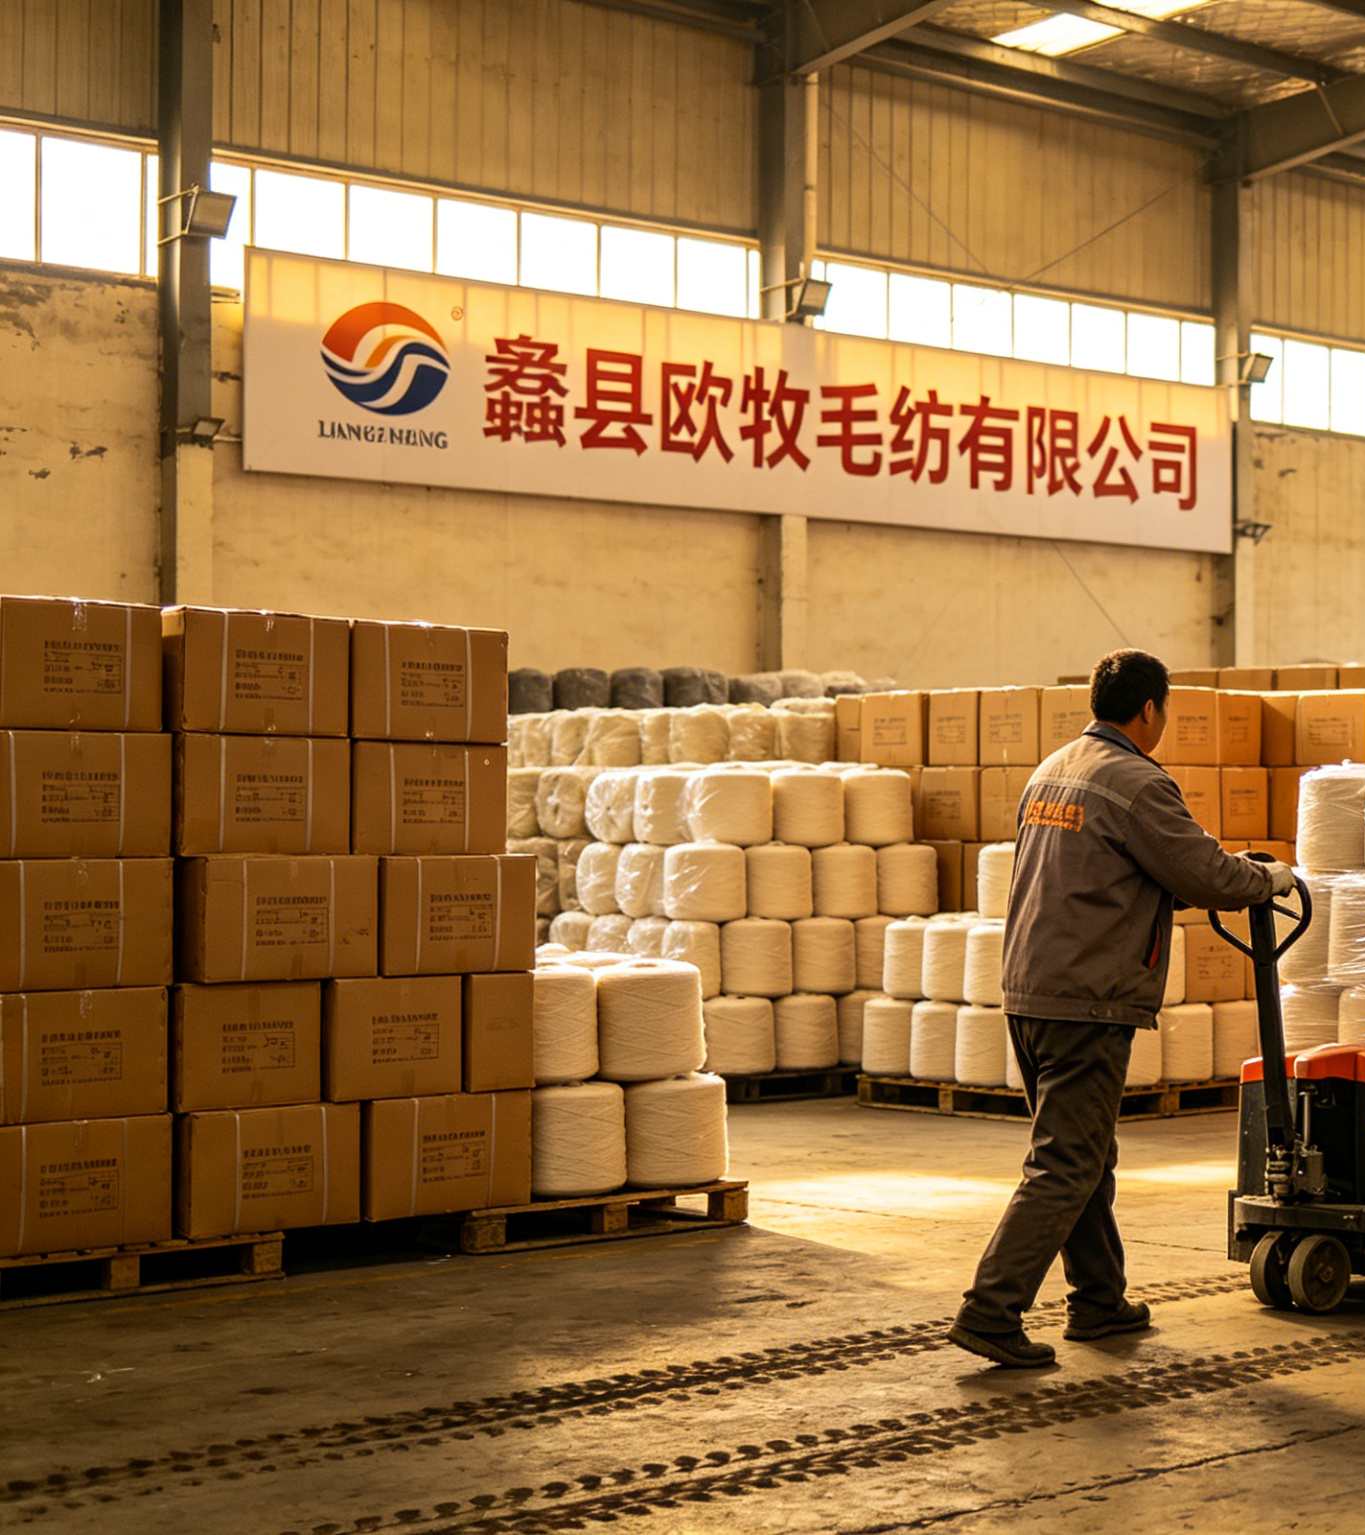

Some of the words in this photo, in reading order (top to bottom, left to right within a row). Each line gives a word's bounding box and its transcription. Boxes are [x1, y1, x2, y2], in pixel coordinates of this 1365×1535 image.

[482, 333, 1198, 511] 蠡县欧牧毛纺有限公司
